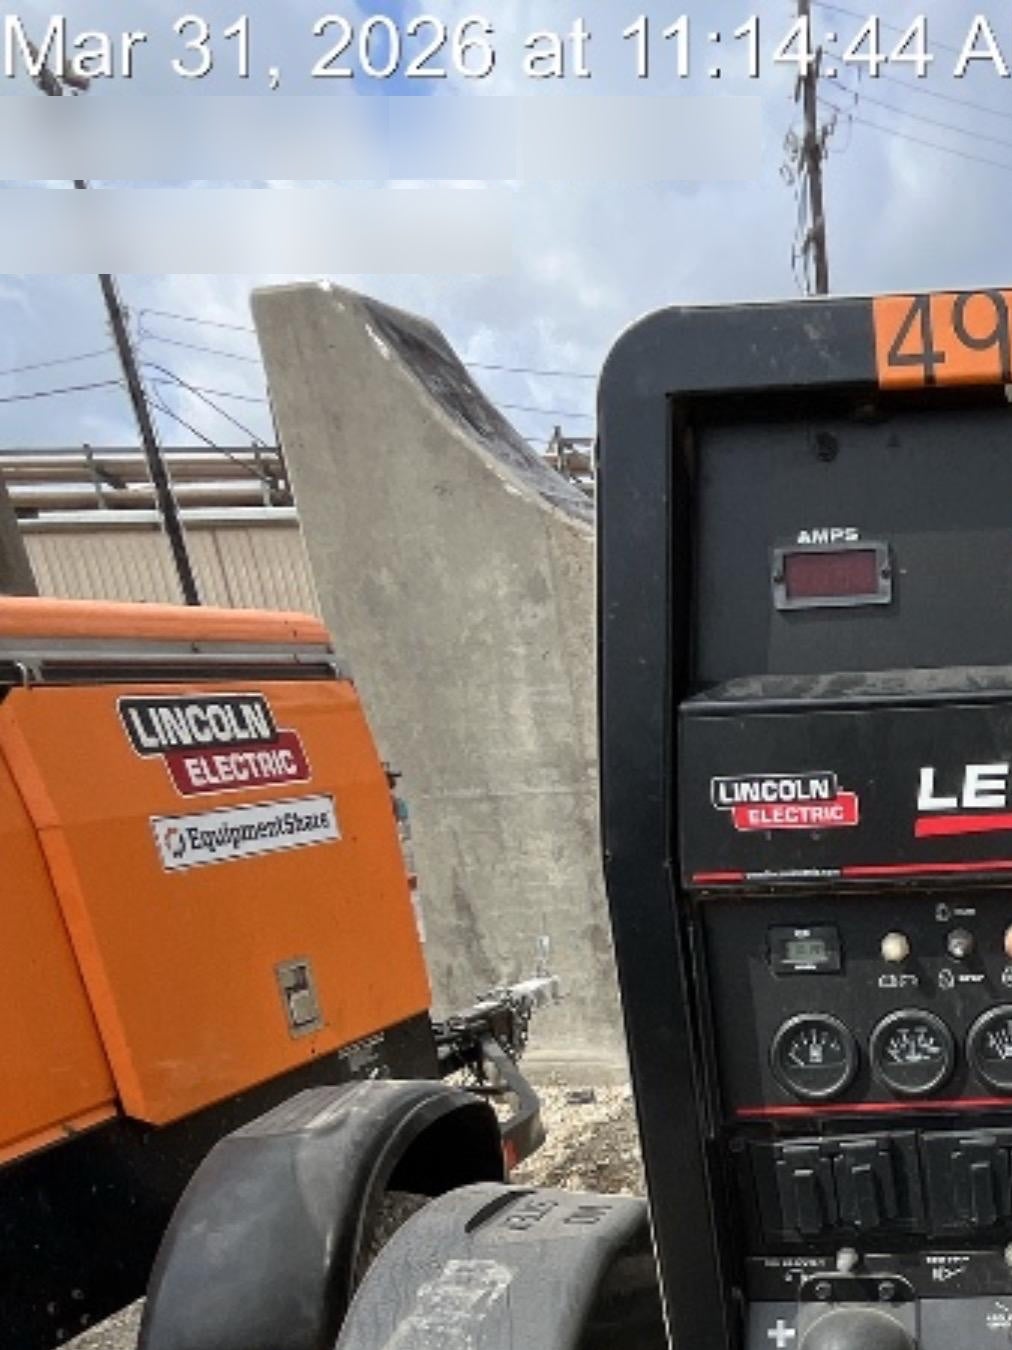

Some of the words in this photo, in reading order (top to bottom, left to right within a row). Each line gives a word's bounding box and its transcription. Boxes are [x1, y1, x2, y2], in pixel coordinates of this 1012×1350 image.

[797, 526, 859, 544] AMPS
[129, 702, 271, 748] LINCOLN
[184, 750, 298, 787] ELECTRIC
[719, 778, 829, 803] LINCOLN
[749, 806, 845, 824] ELECTRIC
[186, 811, 331, 852] EquipmentShare
